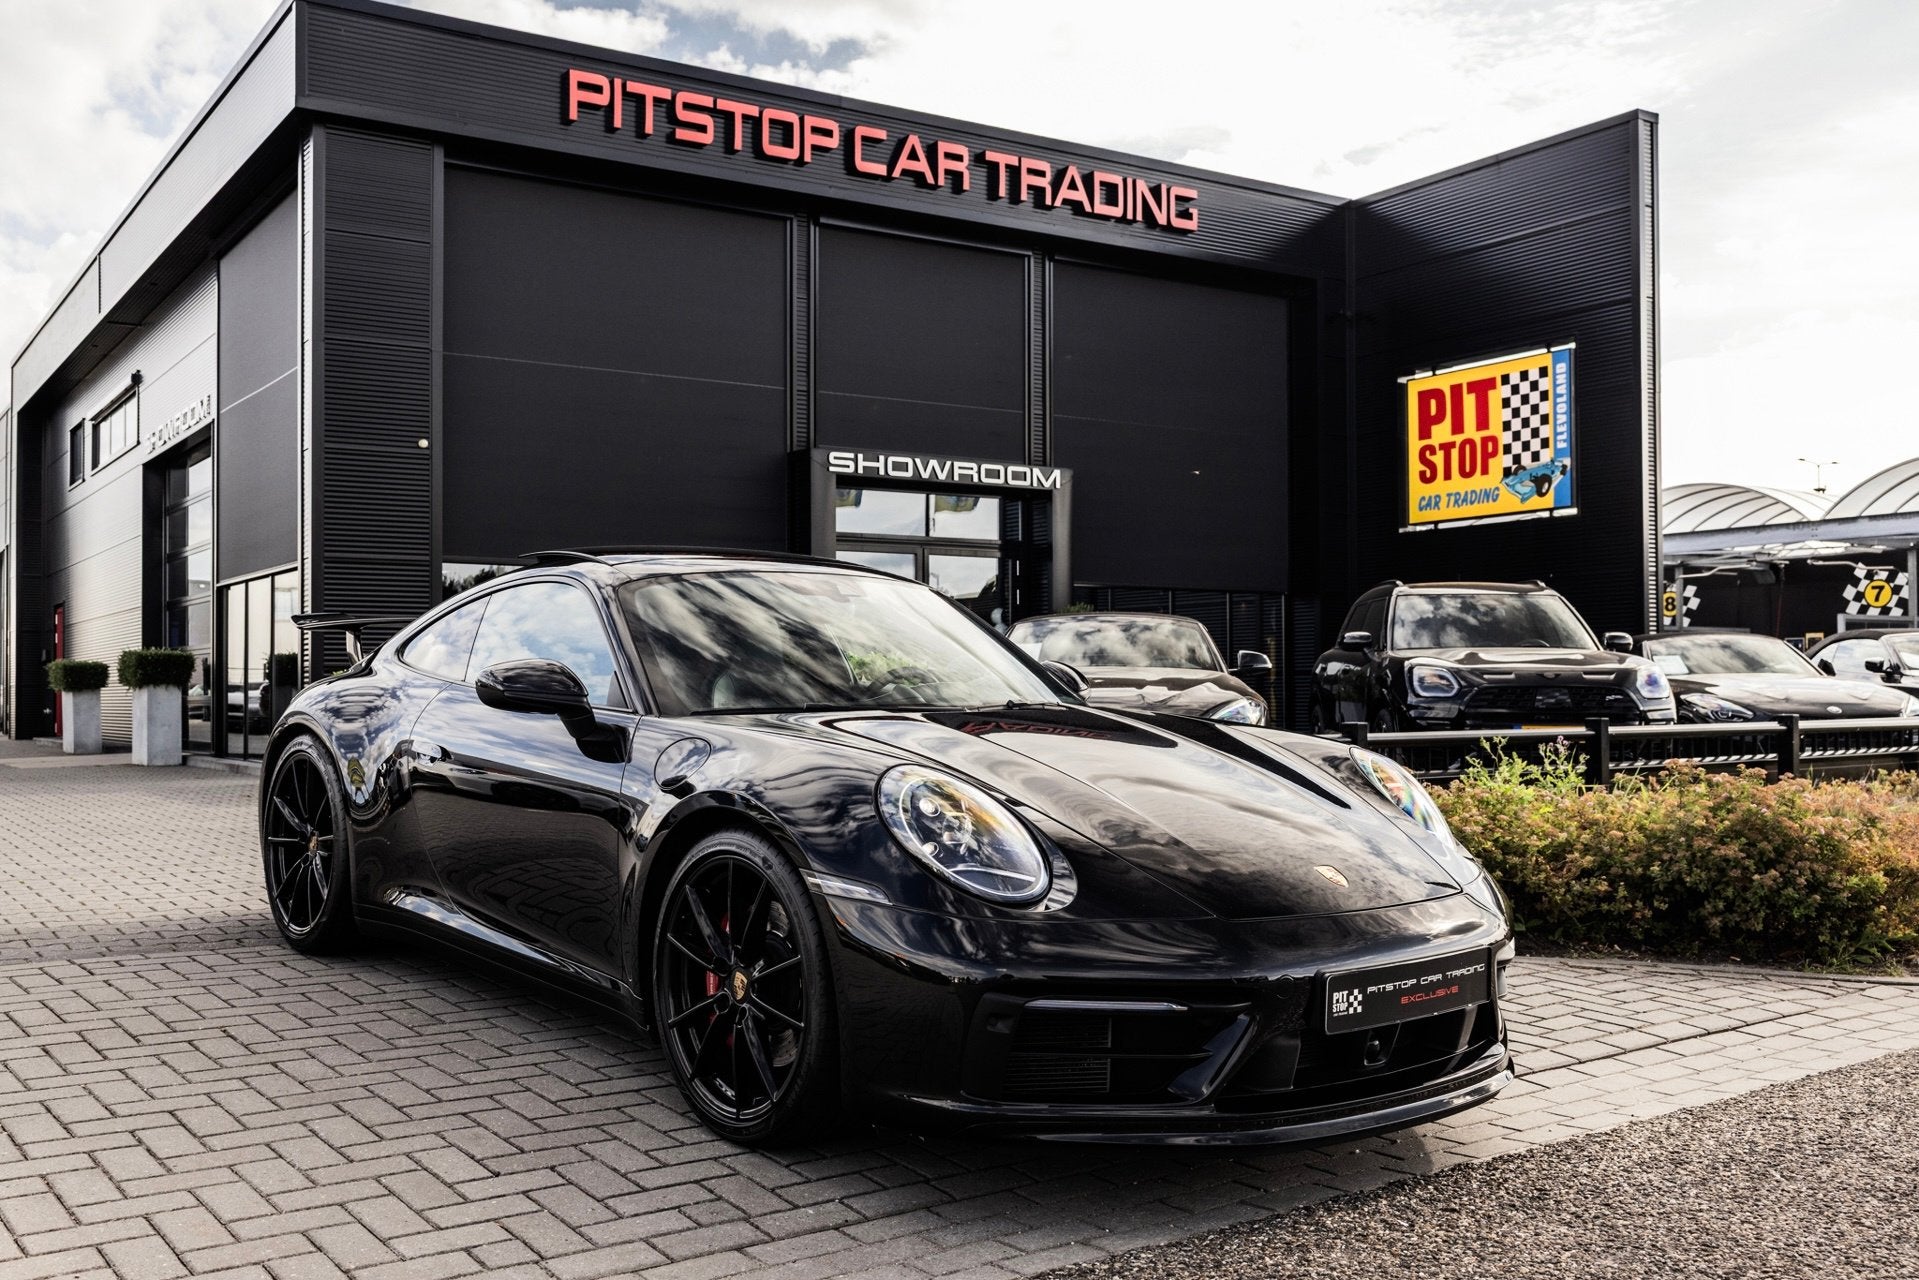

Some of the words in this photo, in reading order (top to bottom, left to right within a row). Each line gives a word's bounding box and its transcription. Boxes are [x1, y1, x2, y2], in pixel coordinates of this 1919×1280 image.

[567, 69, 840, 163] PITSTOP
[853, 125, 970, 191] CAR
[984, 150, 1198, 232] TRADING
[1417, 376, 1497, 441] PIT
[1556, 362, 1568, 449] FLEVOLAND
[828, 451, 1061, 489] SHOWROOM
[1418, 434, 1499, 485] STOP
[1418, 494, 1442, 512] CAR
[1446, 486, 1500, 509] TRADING
[1664, 596, 1676, 612] 8
[1871, 585, 1886, 602] 7
[1367, 978, 1417, 994] PITSTOP
[1420, 973, 1443, 986] CAR
[1446, 963, 1486, 978] TRADING
[1333, 990, 1348, 1004] PIT
[1333, 1002, 1348, 1013] STOP
[1401, 985, 1459, 1004] EXCLUSIVE
